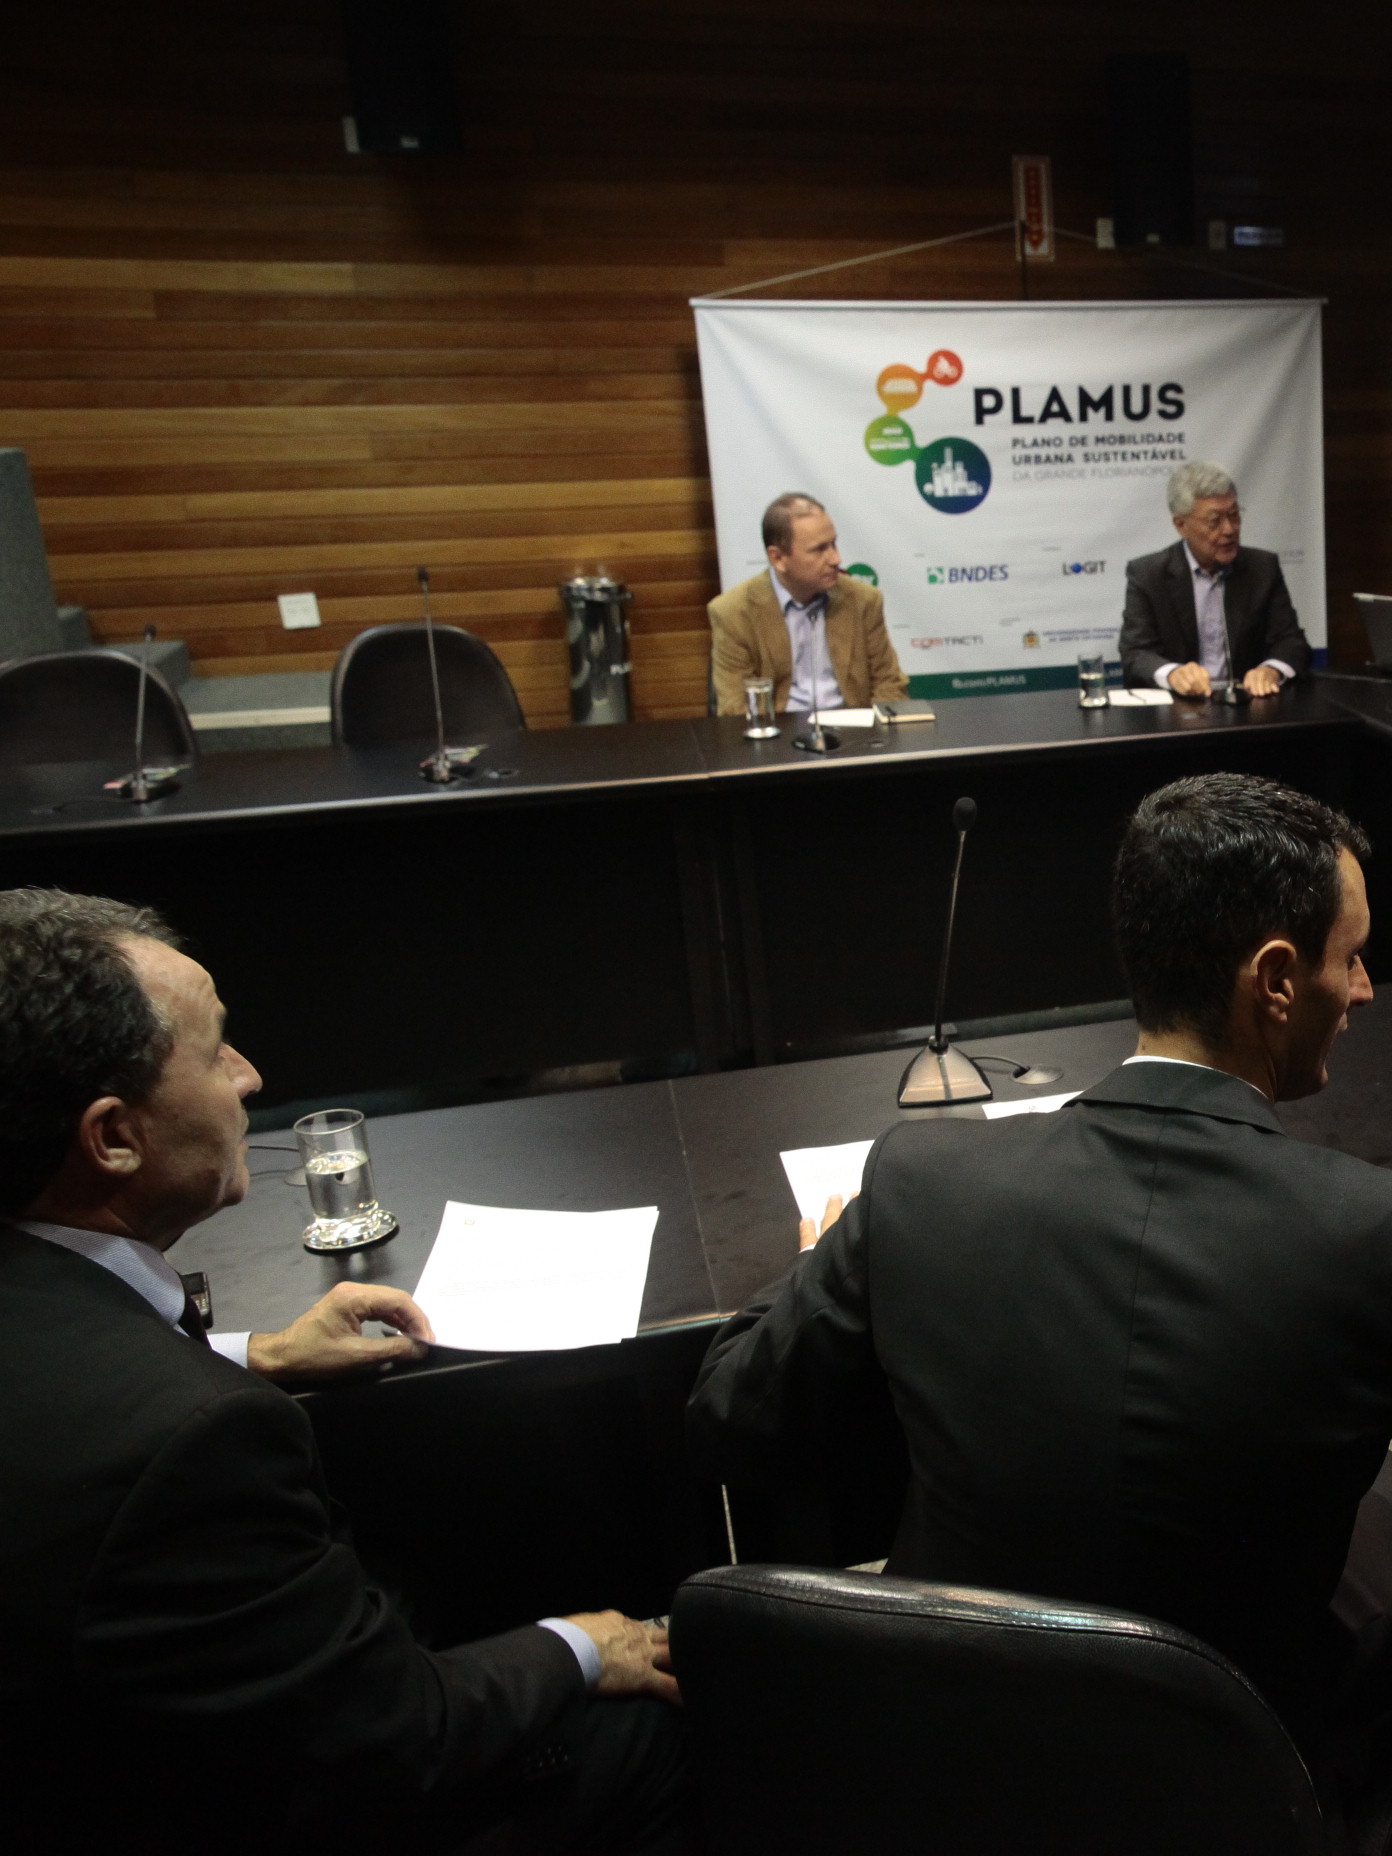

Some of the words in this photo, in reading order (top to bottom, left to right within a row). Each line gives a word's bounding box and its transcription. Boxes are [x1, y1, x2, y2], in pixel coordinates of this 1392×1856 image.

[973, 382, 1185, 426] PLAMUS
[1012, 436, 1063, 449] PLANO
[1068, 435, 1088, 447] DE
[1095, 432, 1185, 446] MOBILIDADE
[1012, 453, 1074, 466] URBANA
[1083, 449, 1187, 464] SUSTENTÁVEL
[948, 564, 1009, 583] BNDES
[1062, 560, 1106, 576] LOGIT
